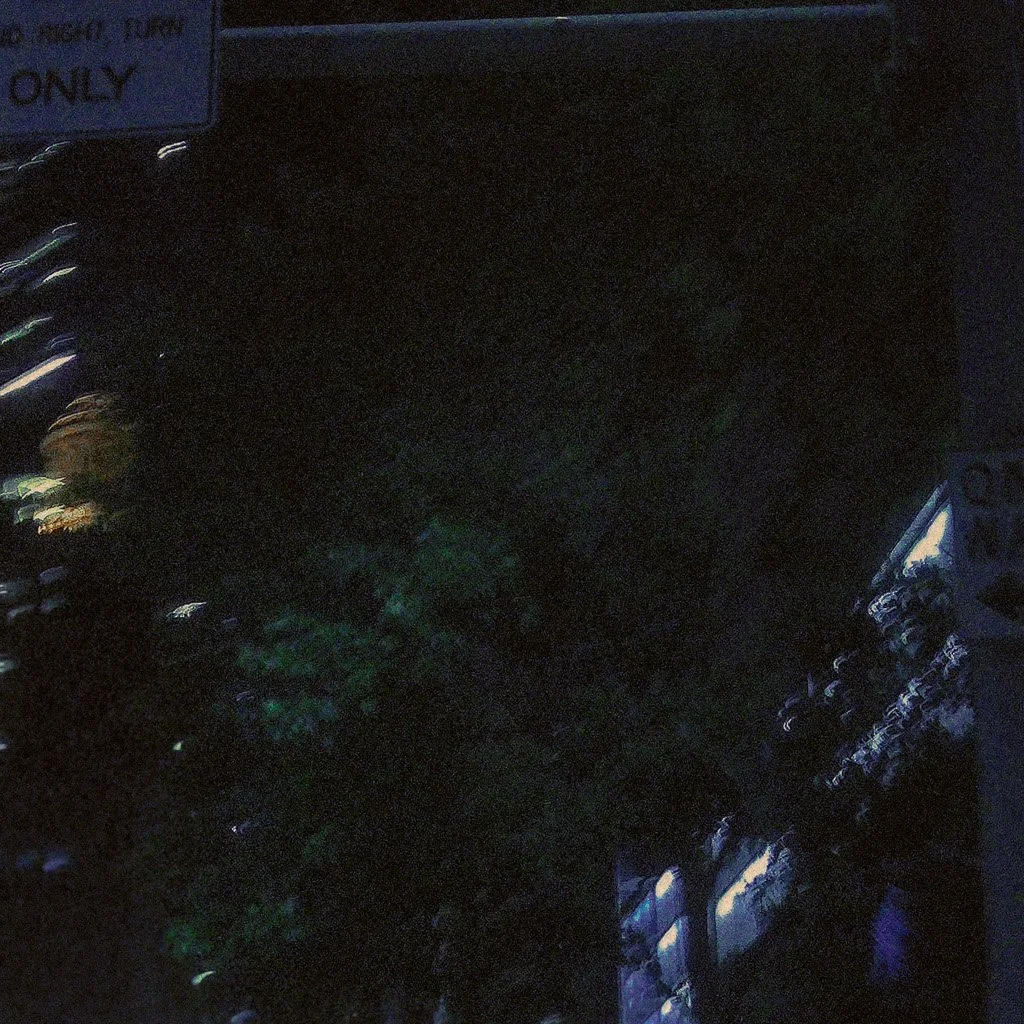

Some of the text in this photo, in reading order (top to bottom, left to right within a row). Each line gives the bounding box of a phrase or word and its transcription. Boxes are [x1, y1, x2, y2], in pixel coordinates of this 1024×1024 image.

[124, 15, 185, 42] TURN
[9, 65, 137, 106] ONLY
[961, 461, 1024, 506] ON
